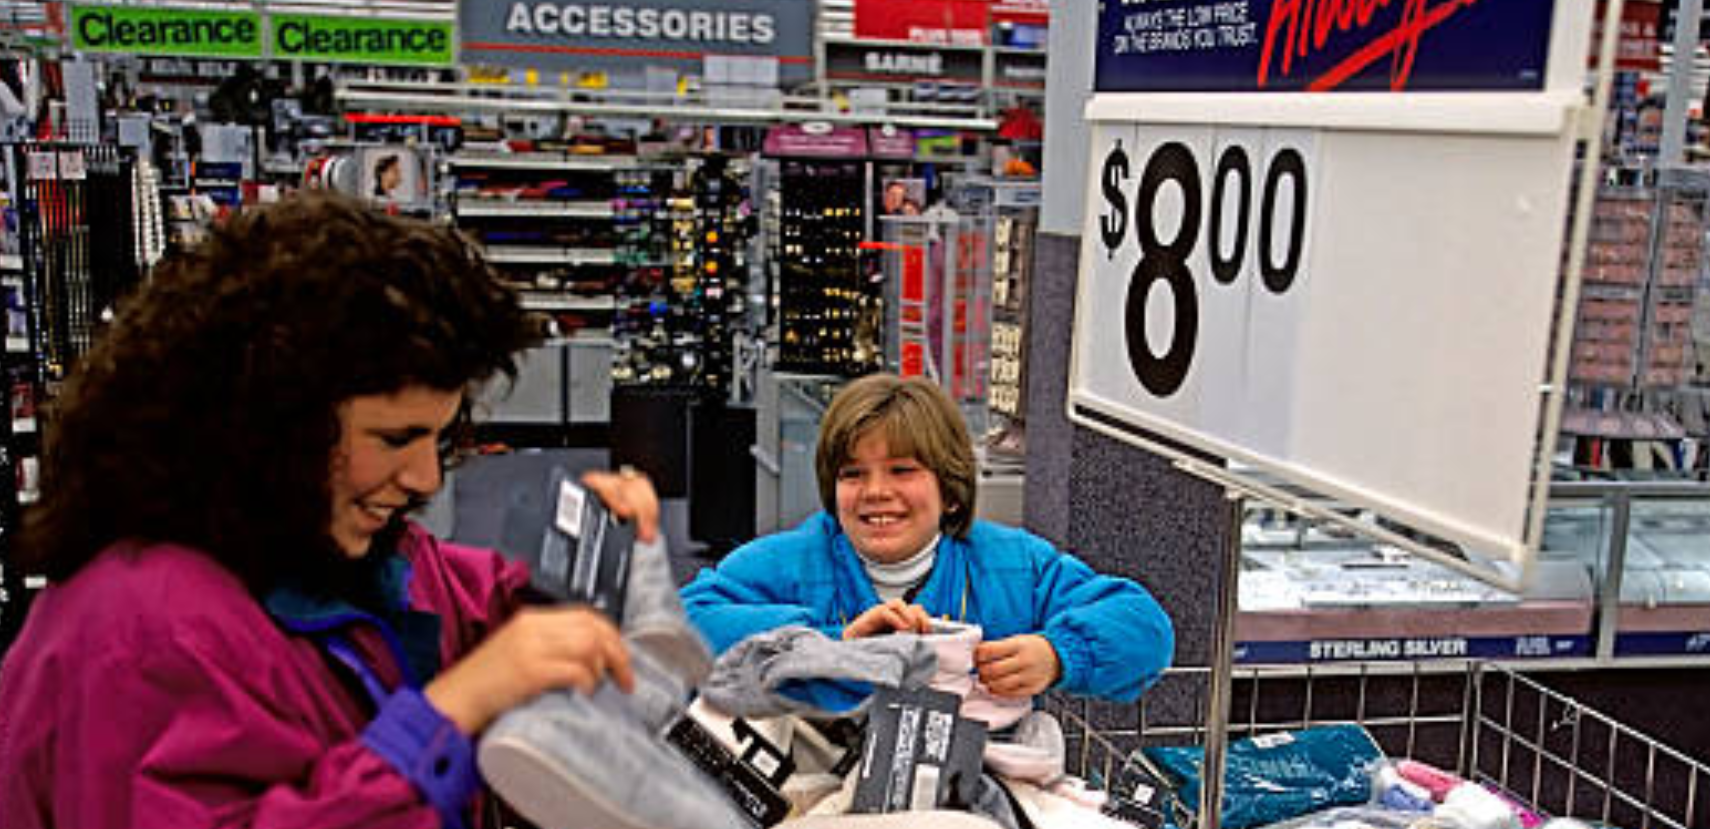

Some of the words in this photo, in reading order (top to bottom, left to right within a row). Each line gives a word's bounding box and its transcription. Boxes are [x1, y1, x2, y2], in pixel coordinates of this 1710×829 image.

[507, 2, 775, 43] ACCESSORIES
[1163, 8, 1185, 28] THE
[1187, 6, 1212, 27] LOW
[1213, 1, 1248, 24] PRICE
[78, 12, 255, 47] Clearance
[277, 21, 446, 52] Clearance
[1148, 28, 1192, 51] BRANDS
[1310, 640, 1399, 659] STERLING
[1404, 638, 1468, 656] SILVER
